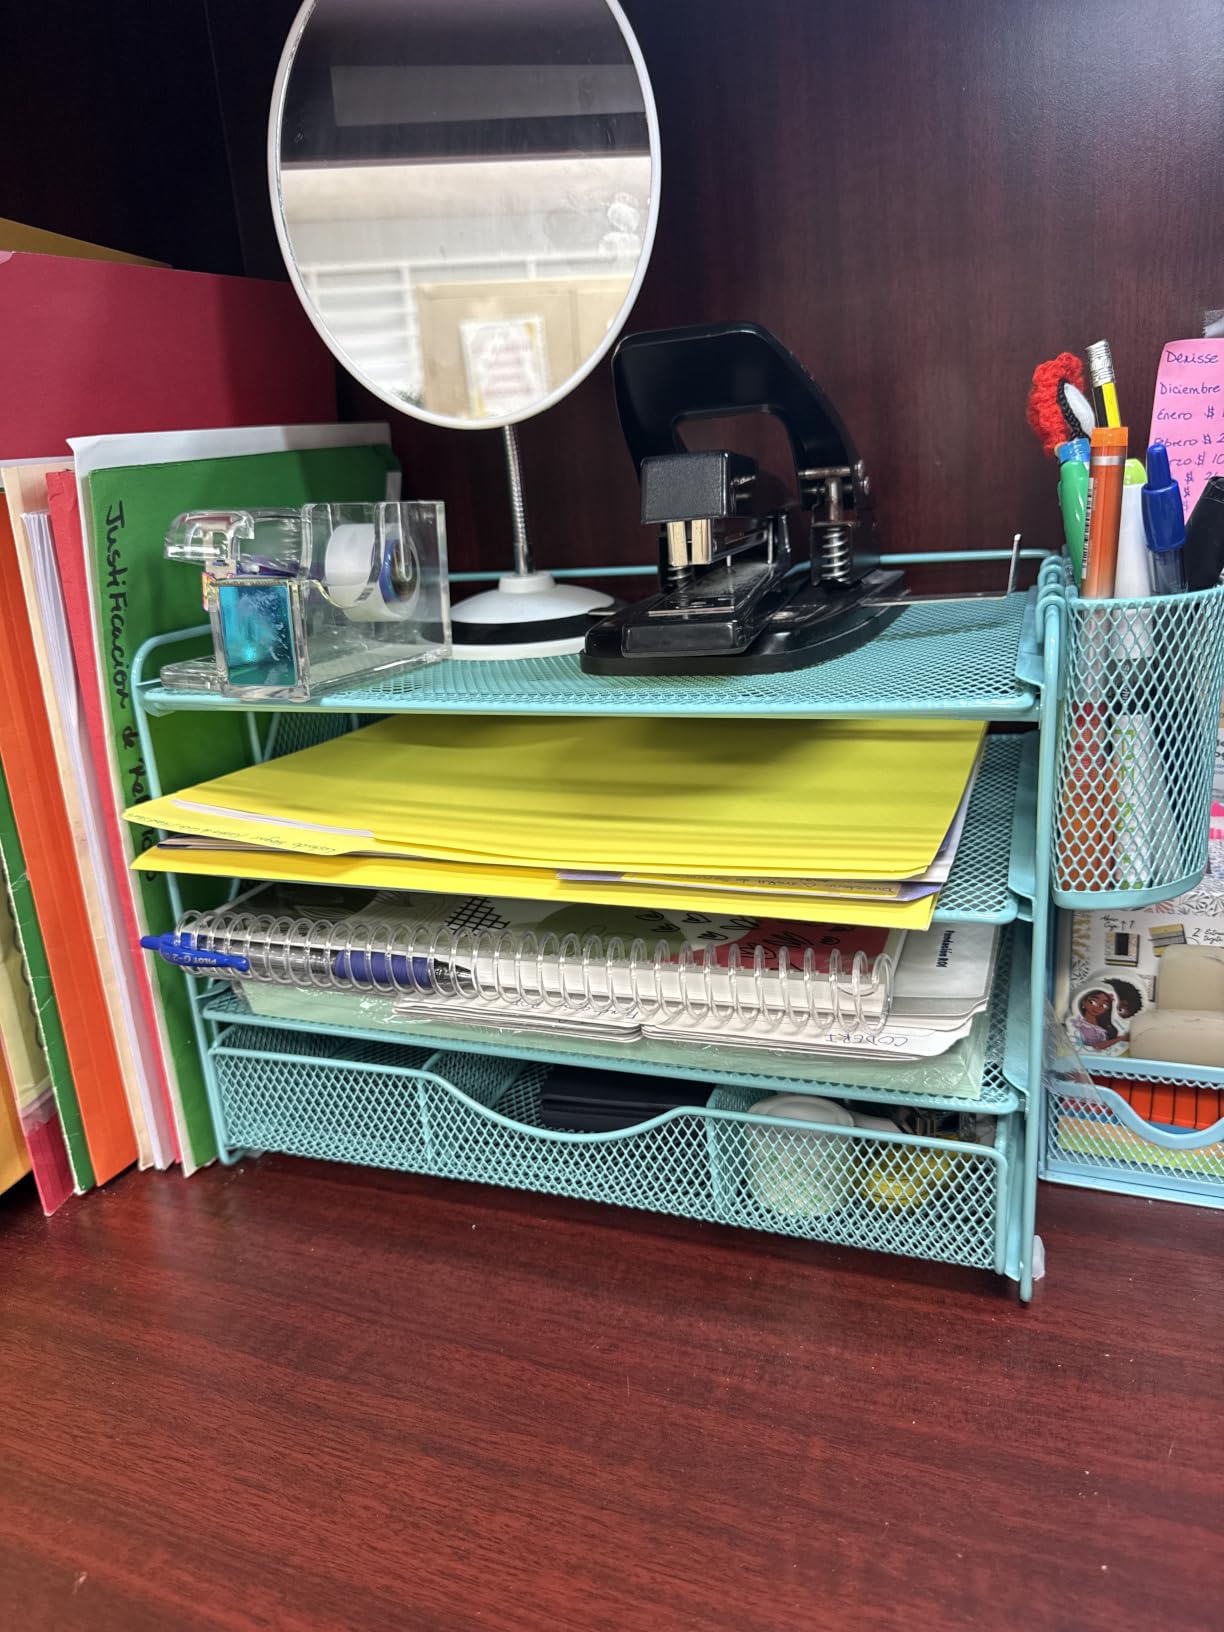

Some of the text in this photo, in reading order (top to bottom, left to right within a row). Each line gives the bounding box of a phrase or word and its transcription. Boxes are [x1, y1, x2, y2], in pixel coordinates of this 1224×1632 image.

[1159, 381, 1221, 395] Diciembre
[1156, 408, 1193, 421] Enero
[192, 957, 217, 966] PILOT
